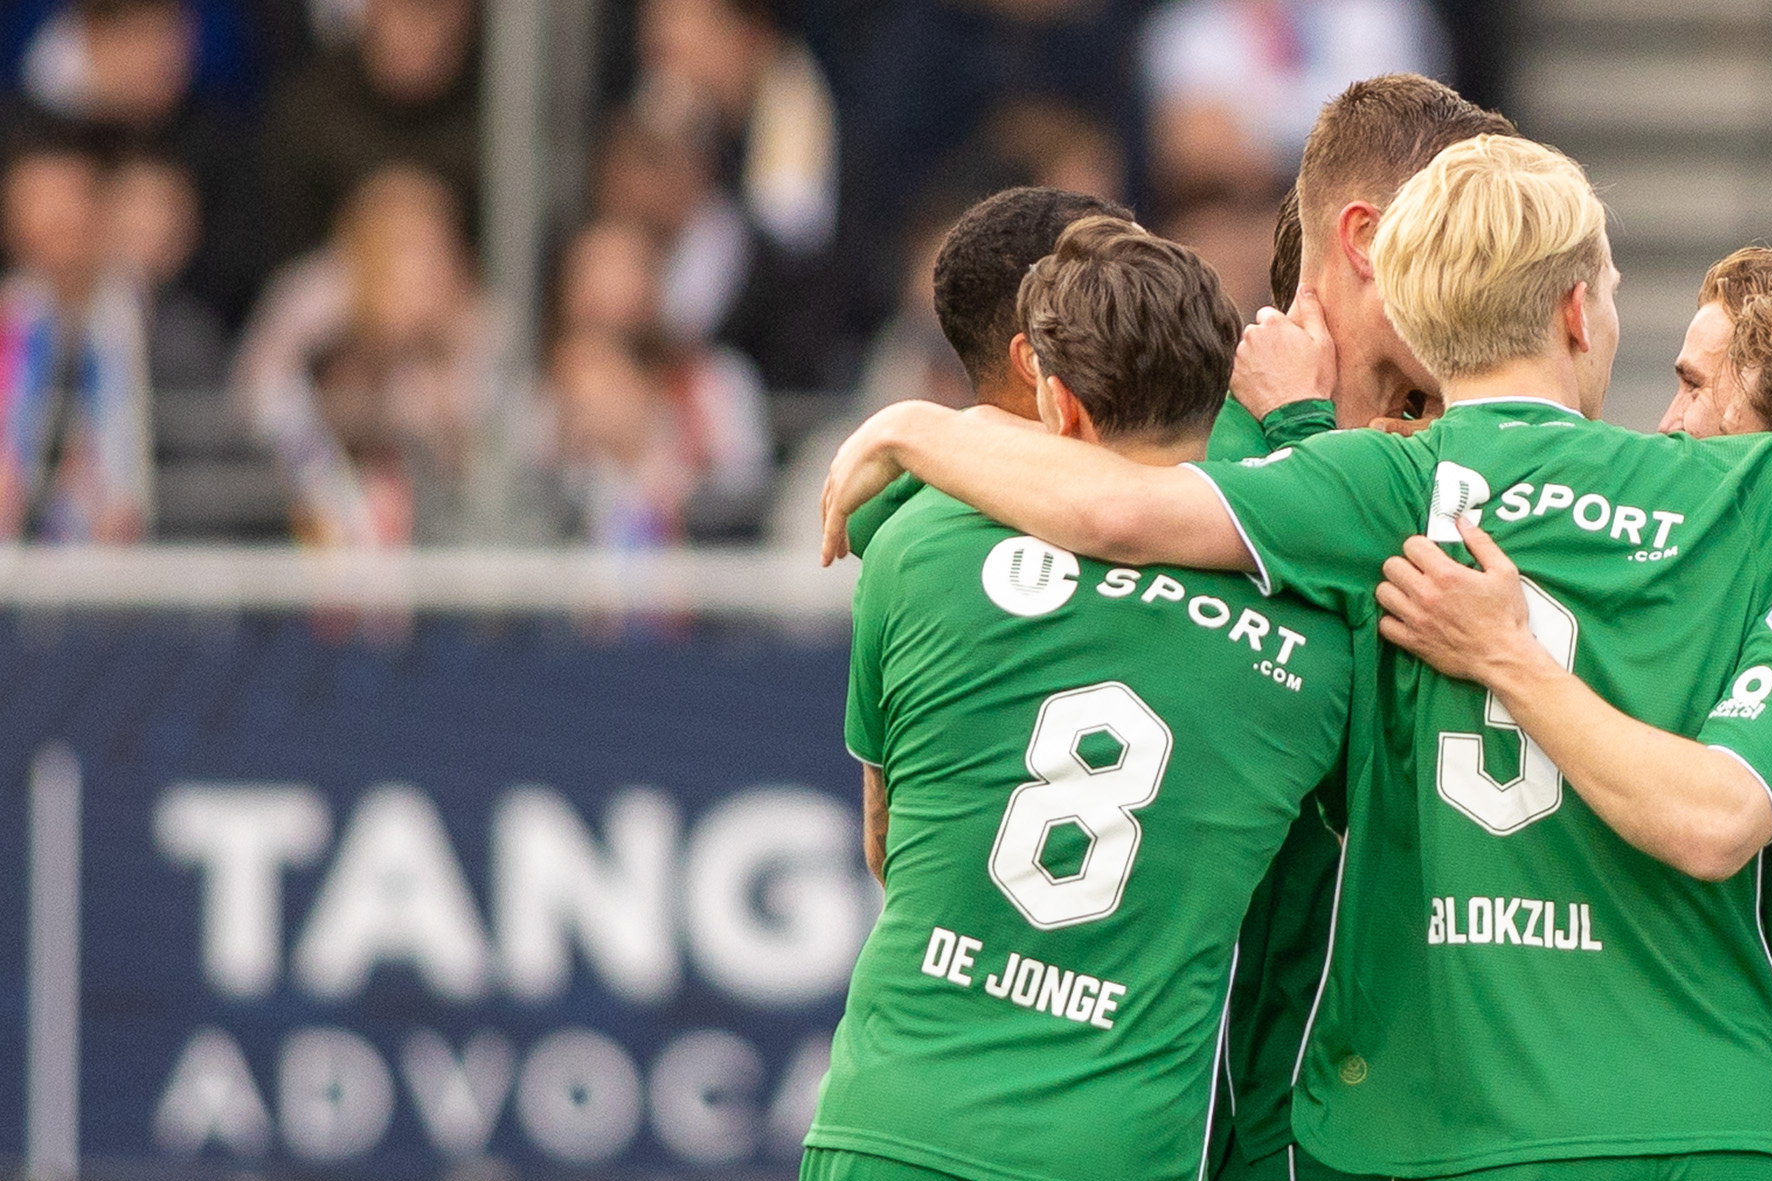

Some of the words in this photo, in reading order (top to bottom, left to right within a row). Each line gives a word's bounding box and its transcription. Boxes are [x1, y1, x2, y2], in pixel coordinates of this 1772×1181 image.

[1495, 482, 1685, 549] SPORT
[1627, 545, 1679, 562] .COM
[1096, 567, 1307, 665] SPORT
[1253, 659, 1303, 692] .COM
[1436, 574, 1579, 837] 3
[987, 680, 1174, 931] 8
[155, 783, 883, 1004] TANG
[1427, 896, 1603, 951] BLOKZIJL
[921, 926, 984, 988] DE
[984, 952, 1127, 1030] JONGE
